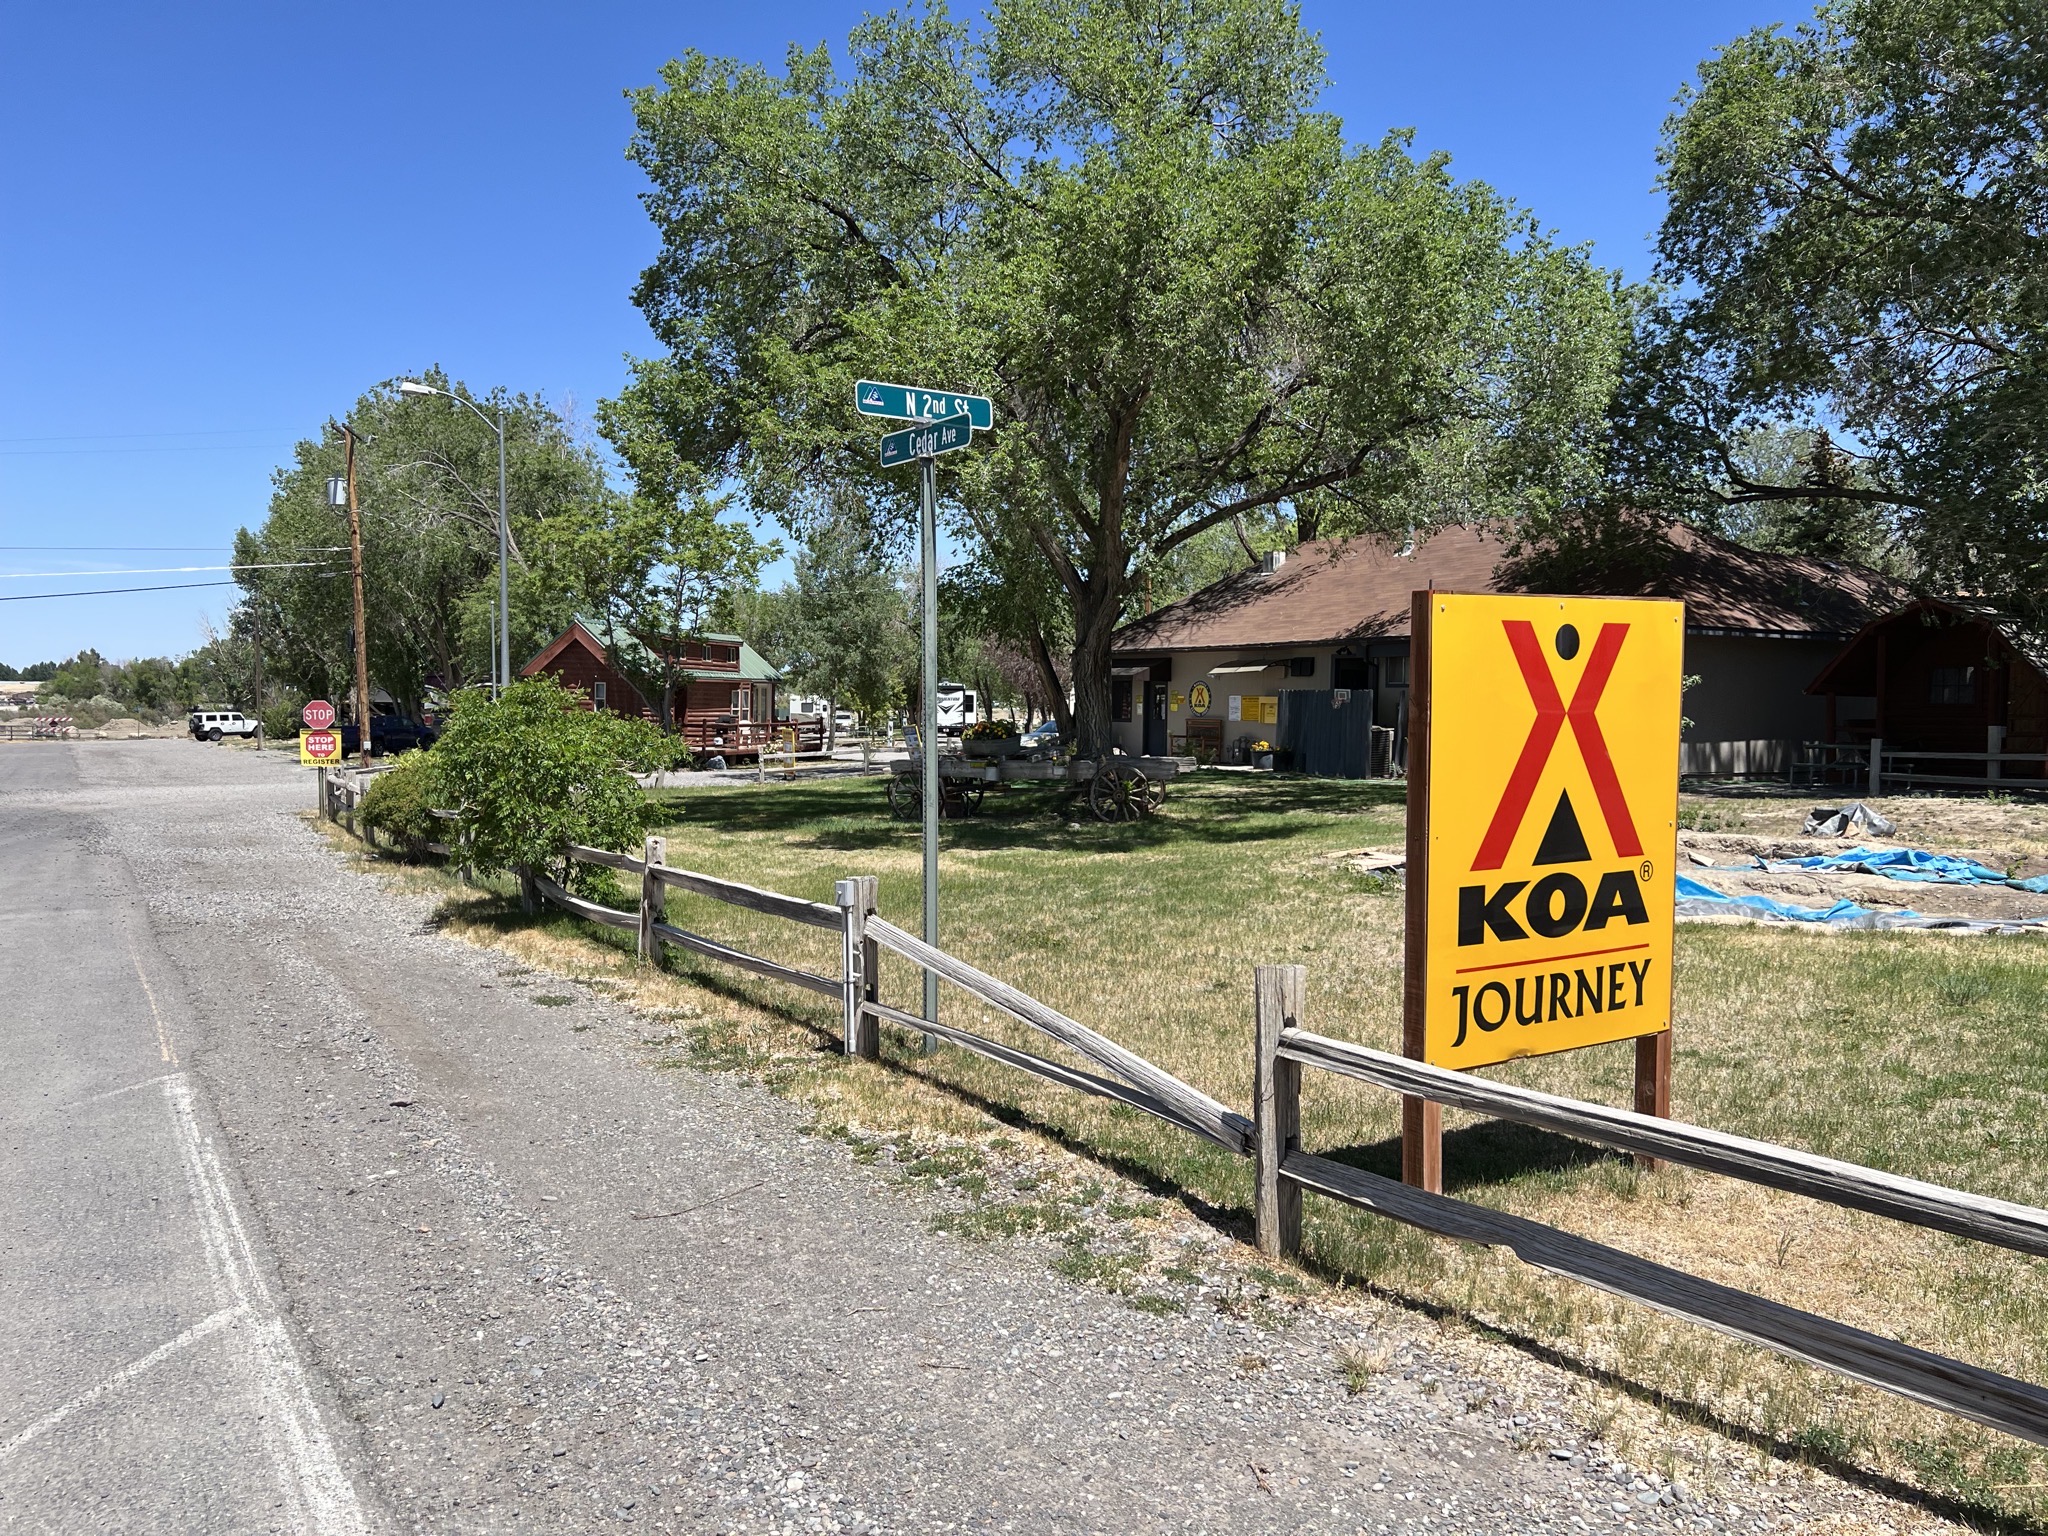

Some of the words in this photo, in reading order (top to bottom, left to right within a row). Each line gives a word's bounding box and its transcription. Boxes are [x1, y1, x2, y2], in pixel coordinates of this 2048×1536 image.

[906, 391, 916, 416] N
[922, 394, 946, 418] 2nd
[909, 430, 938, 456] Cedar
[941, 426, 957, 446] Ave
[305, 709, 333, 720] STOP
[1457, 870, 1650, 947] KOA
[1451, 958, 1652, 1047] JOURNEY
